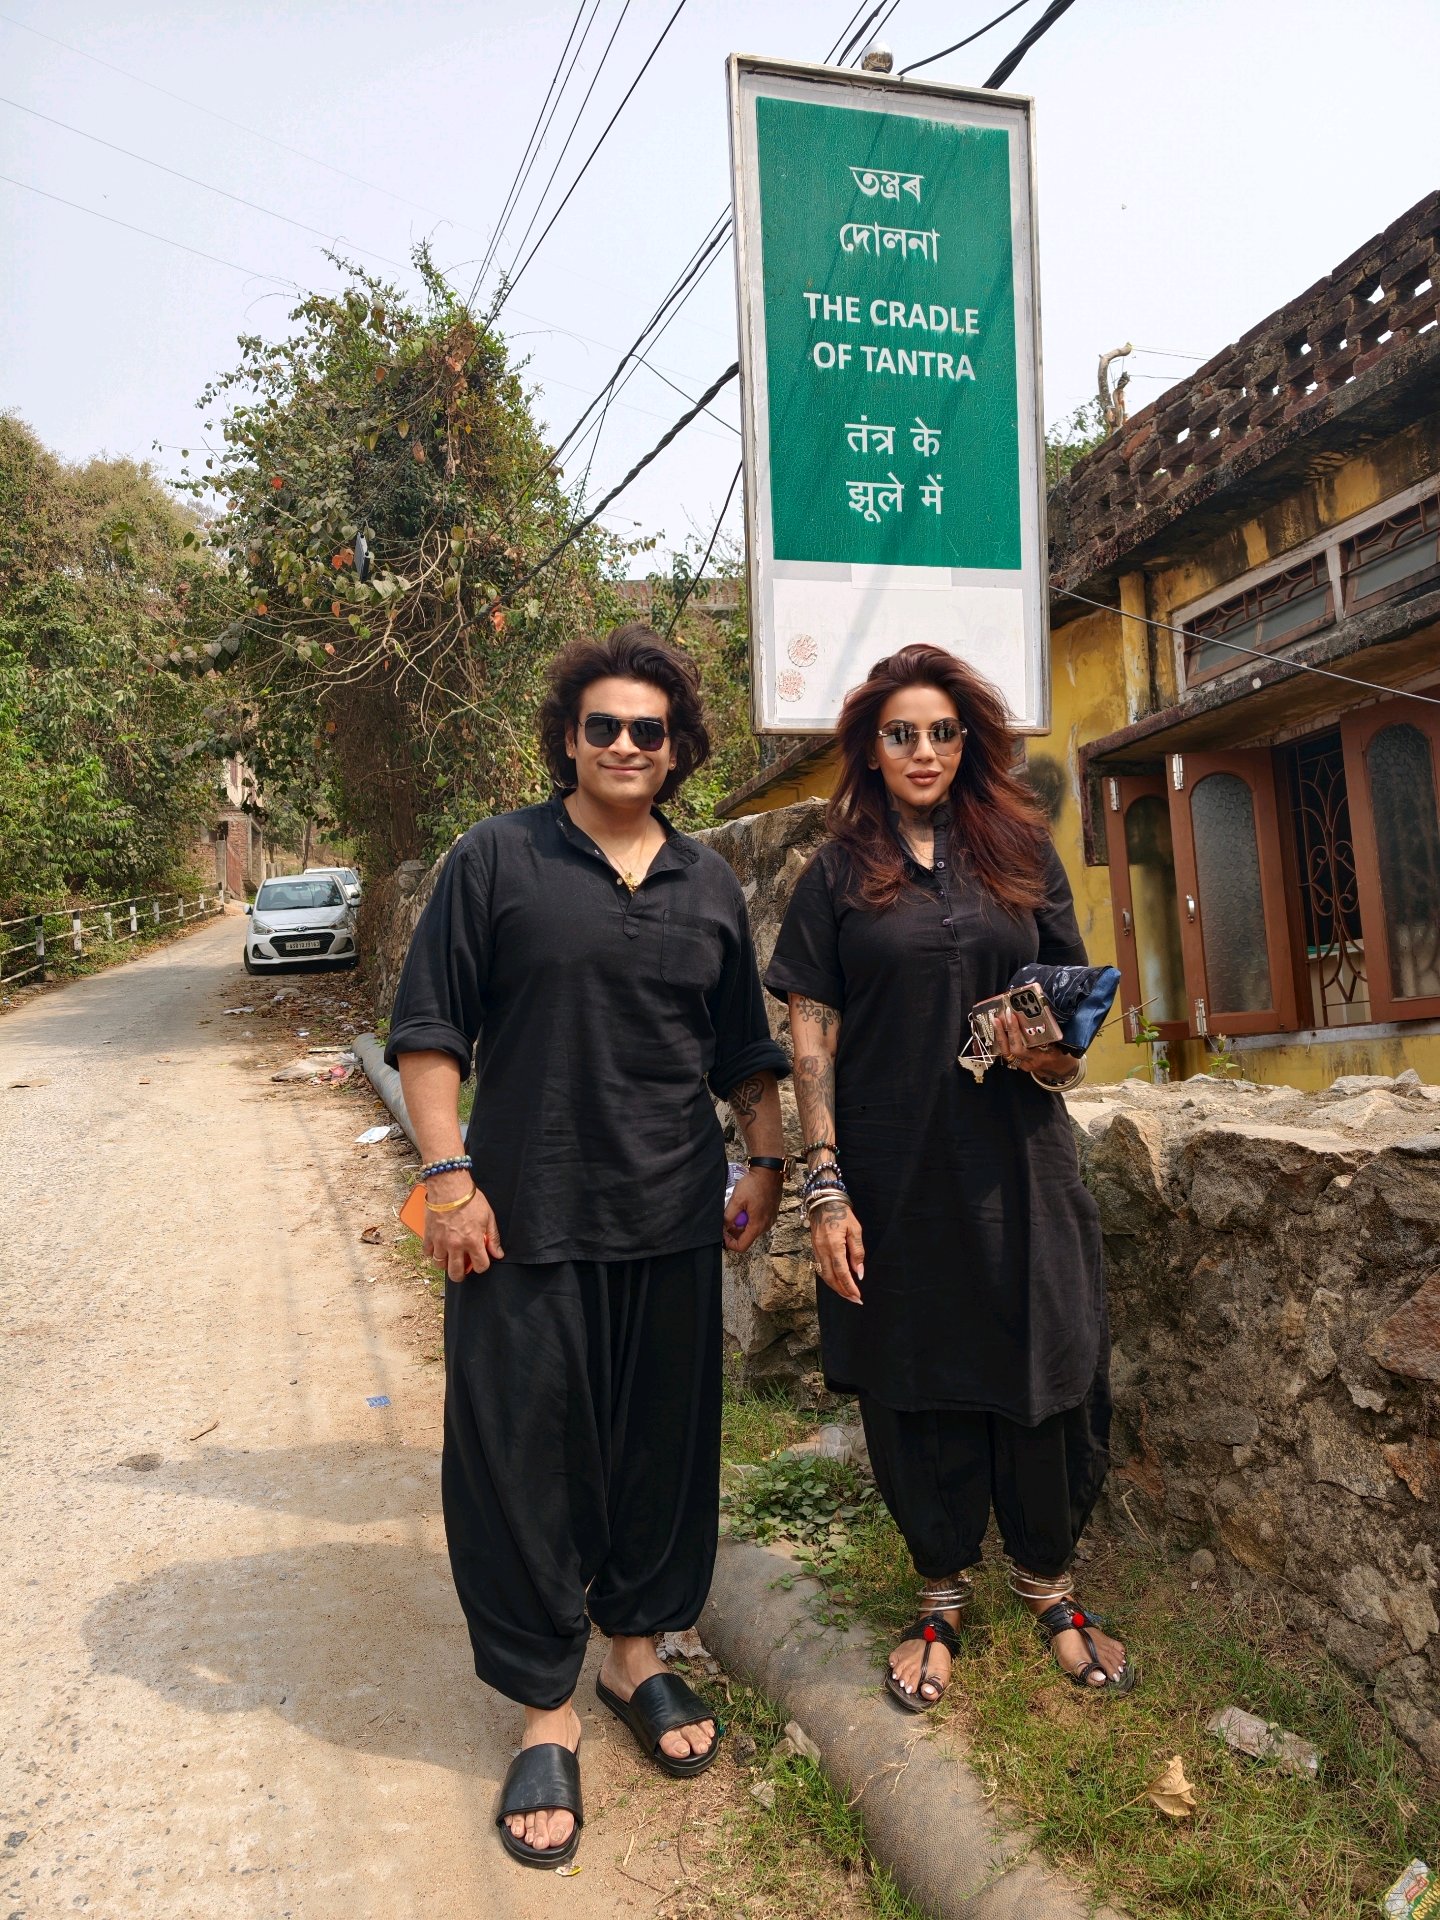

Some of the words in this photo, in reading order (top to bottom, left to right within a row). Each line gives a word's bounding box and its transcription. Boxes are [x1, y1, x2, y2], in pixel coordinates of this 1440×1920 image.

[839, 221, 941, 264] দোলনা
[803, 292, 861, 323] THE
[869, 299, 980, 335] CRADLE
[813, 341, 852, 370] OF
[859, 345, 976, 381] TANTRA
[844, 415, 896, 455] तंत्र
[910, 416, 942, 457] के
[845, 471, 905, 523] झूले
[918, 473, 944, 515] में
